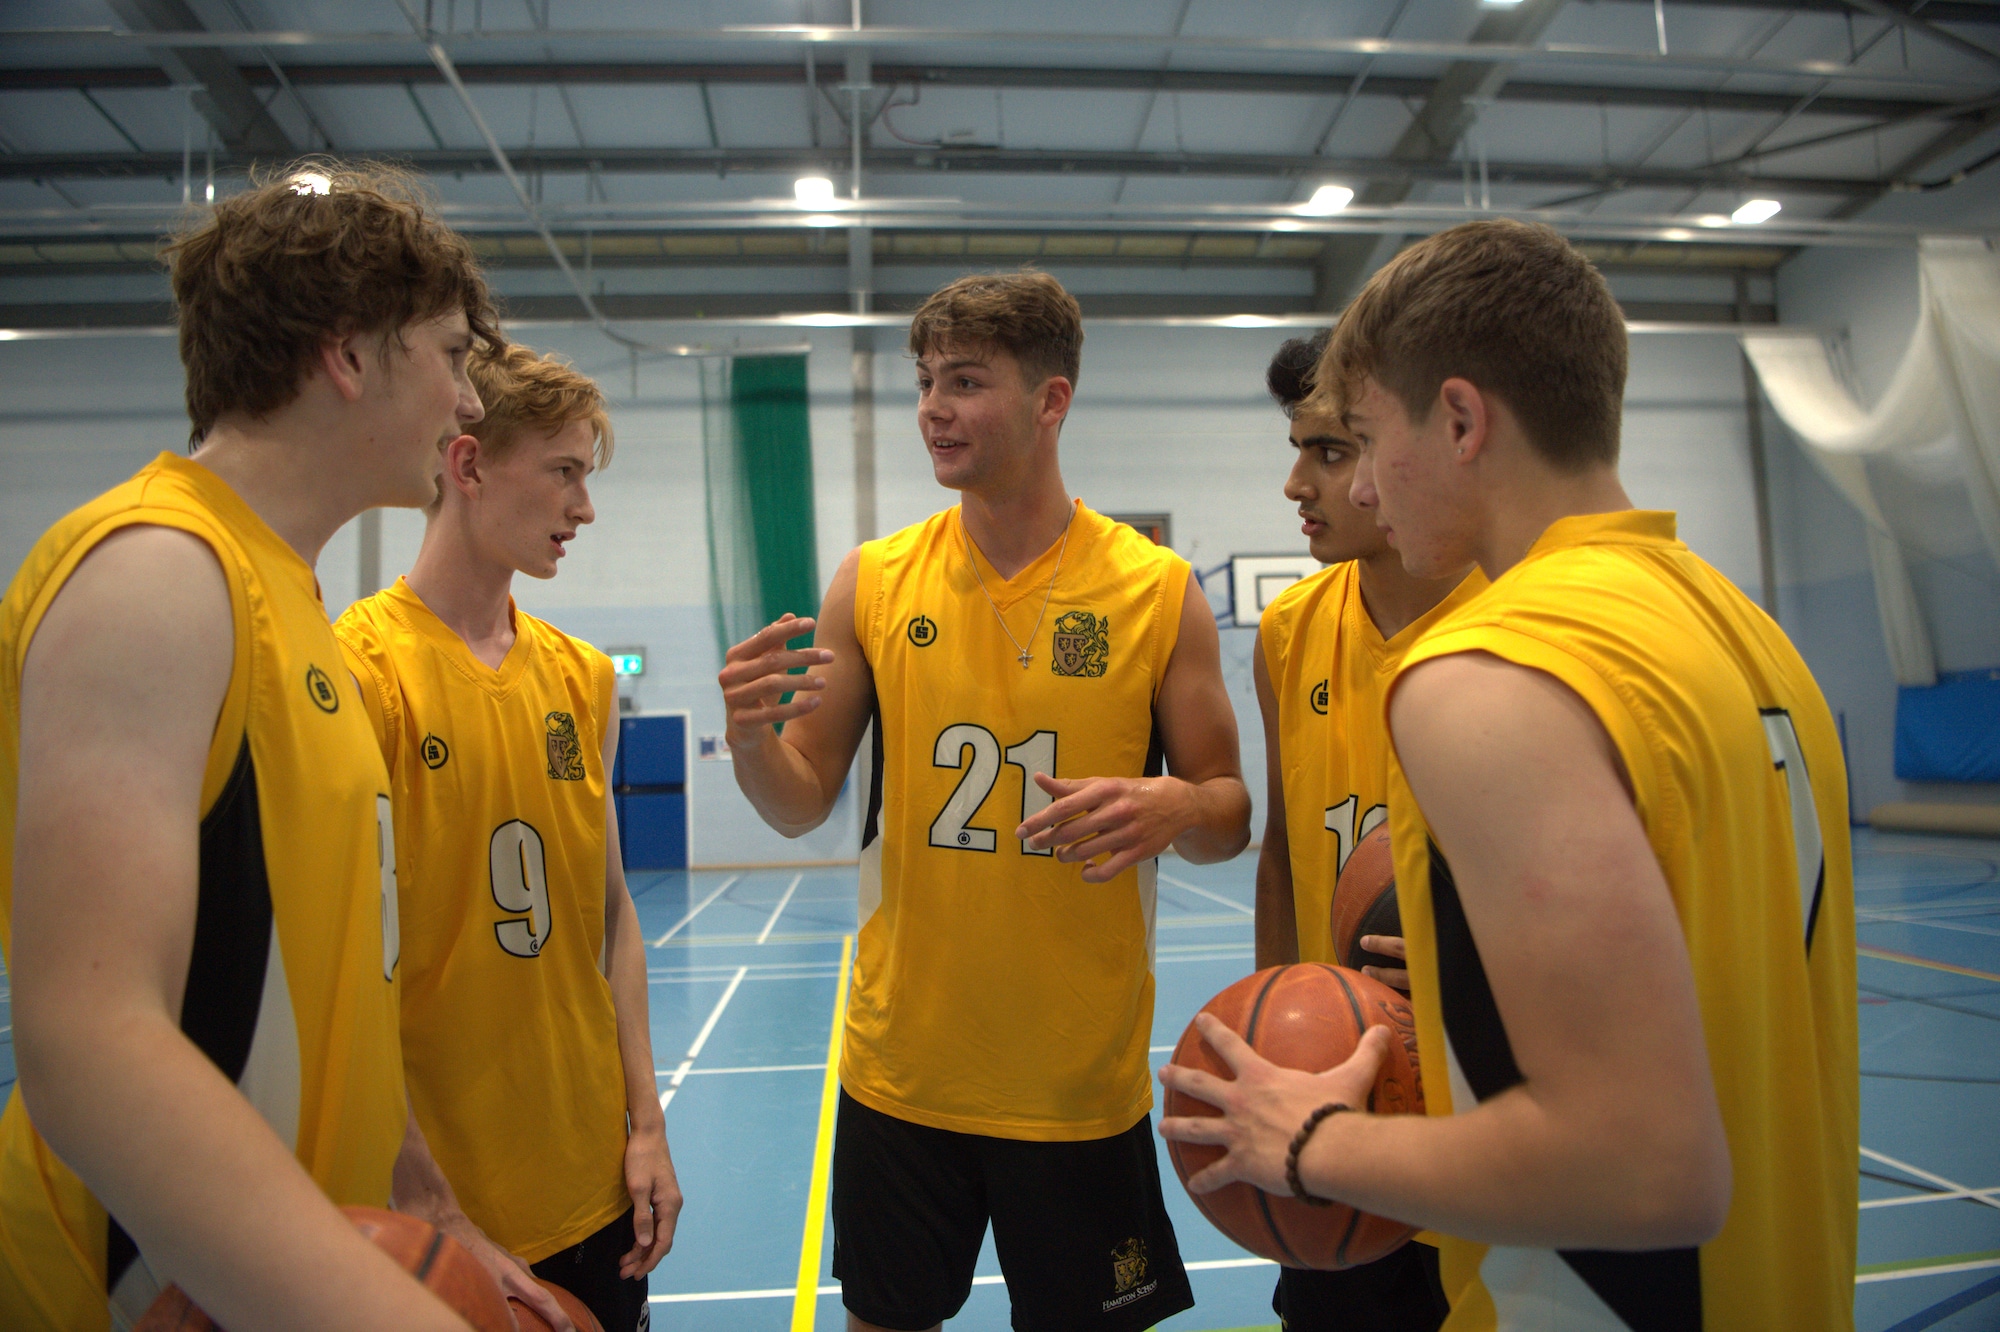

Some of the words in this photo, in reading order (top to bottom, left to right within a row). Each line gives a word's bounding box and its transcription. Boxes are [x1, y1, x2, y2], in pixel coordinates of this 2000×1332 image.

[928, 722, 1058, 857] 21
[1324, 794, 1388, 892] 1
[489, 818, 552, 958] 9
